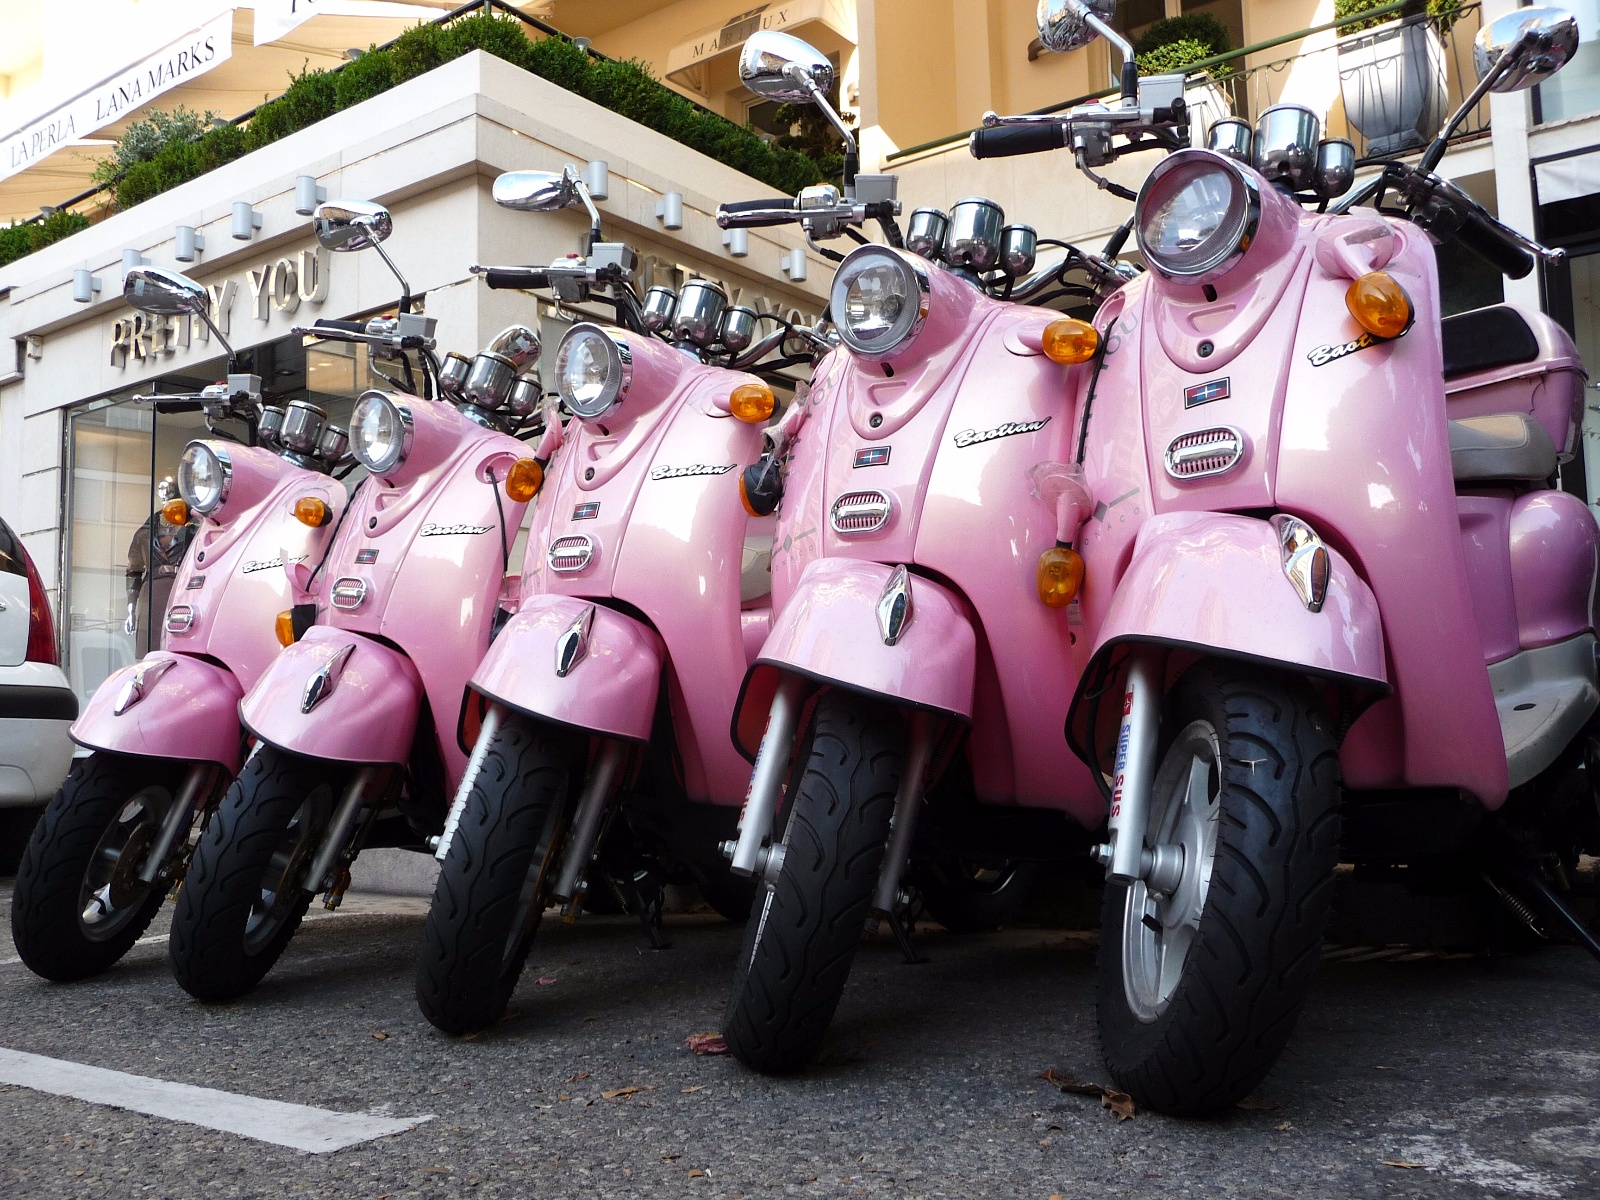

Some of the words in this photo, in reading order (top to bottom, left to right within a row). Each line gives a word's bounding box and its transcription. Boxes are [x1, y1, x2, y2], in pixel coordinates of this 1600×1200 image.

[96, 78, 142, 121] LANA
[147, 36, 215, 93] MARKS
[11, 141, 29, 168] LA
[31, 114, 76, 156] PERLA
[246, 246, 329, 321] YOU
[954, 416, 1051, 448] Baotian
[651, 464, 737, 480] Baotian
[1115, 724, 1130, 773] SUPER
[1111, 774, 1124, 817] SUS
